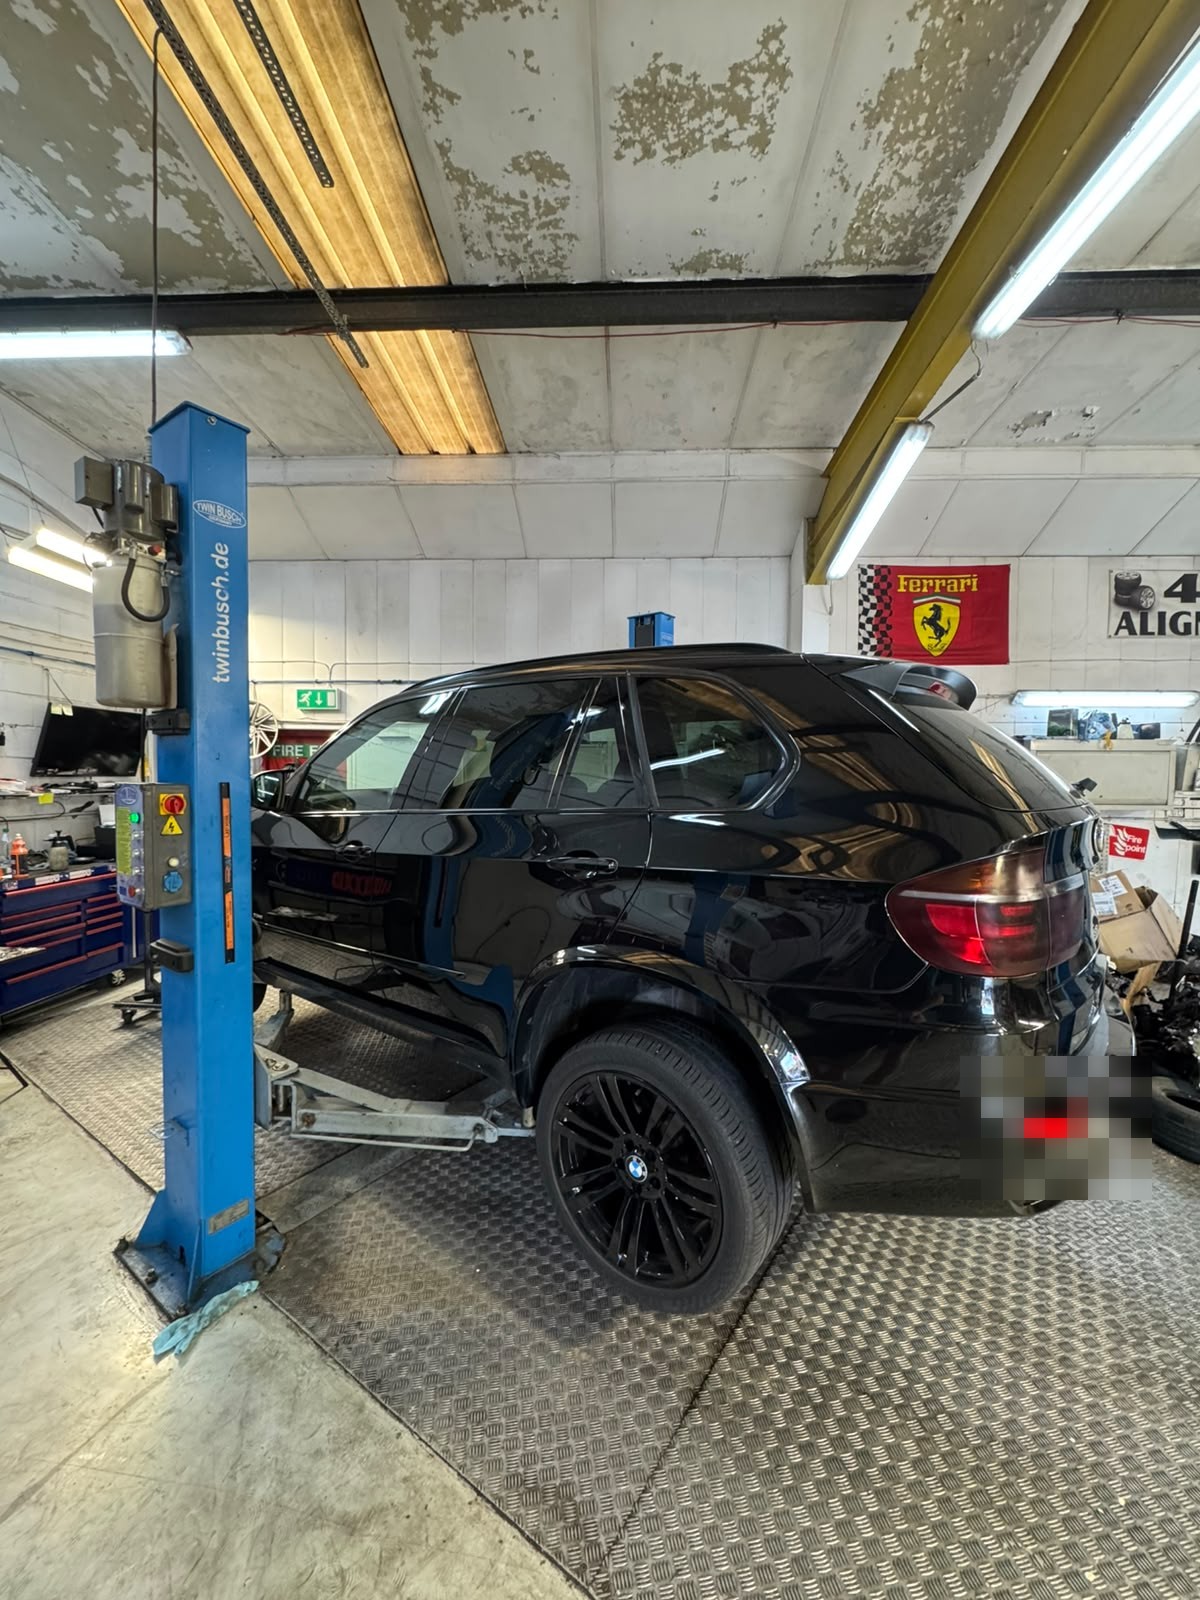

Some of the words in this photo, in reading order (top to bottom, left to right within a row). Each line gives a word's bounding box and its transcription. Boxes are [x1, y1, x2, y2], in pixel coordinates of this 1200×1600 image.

[197, 503, 216, 514] TWIN
[216, 504, 242, 523] BUSCH
[897, 574, 978, 593] Ferrari
[211, 542, 230, 683] twinbusch.de
[272, 744, 304, 757] FIRE
[1126, 834, 1143, 844] Fire
[1125, 844, 1146, 854] point
